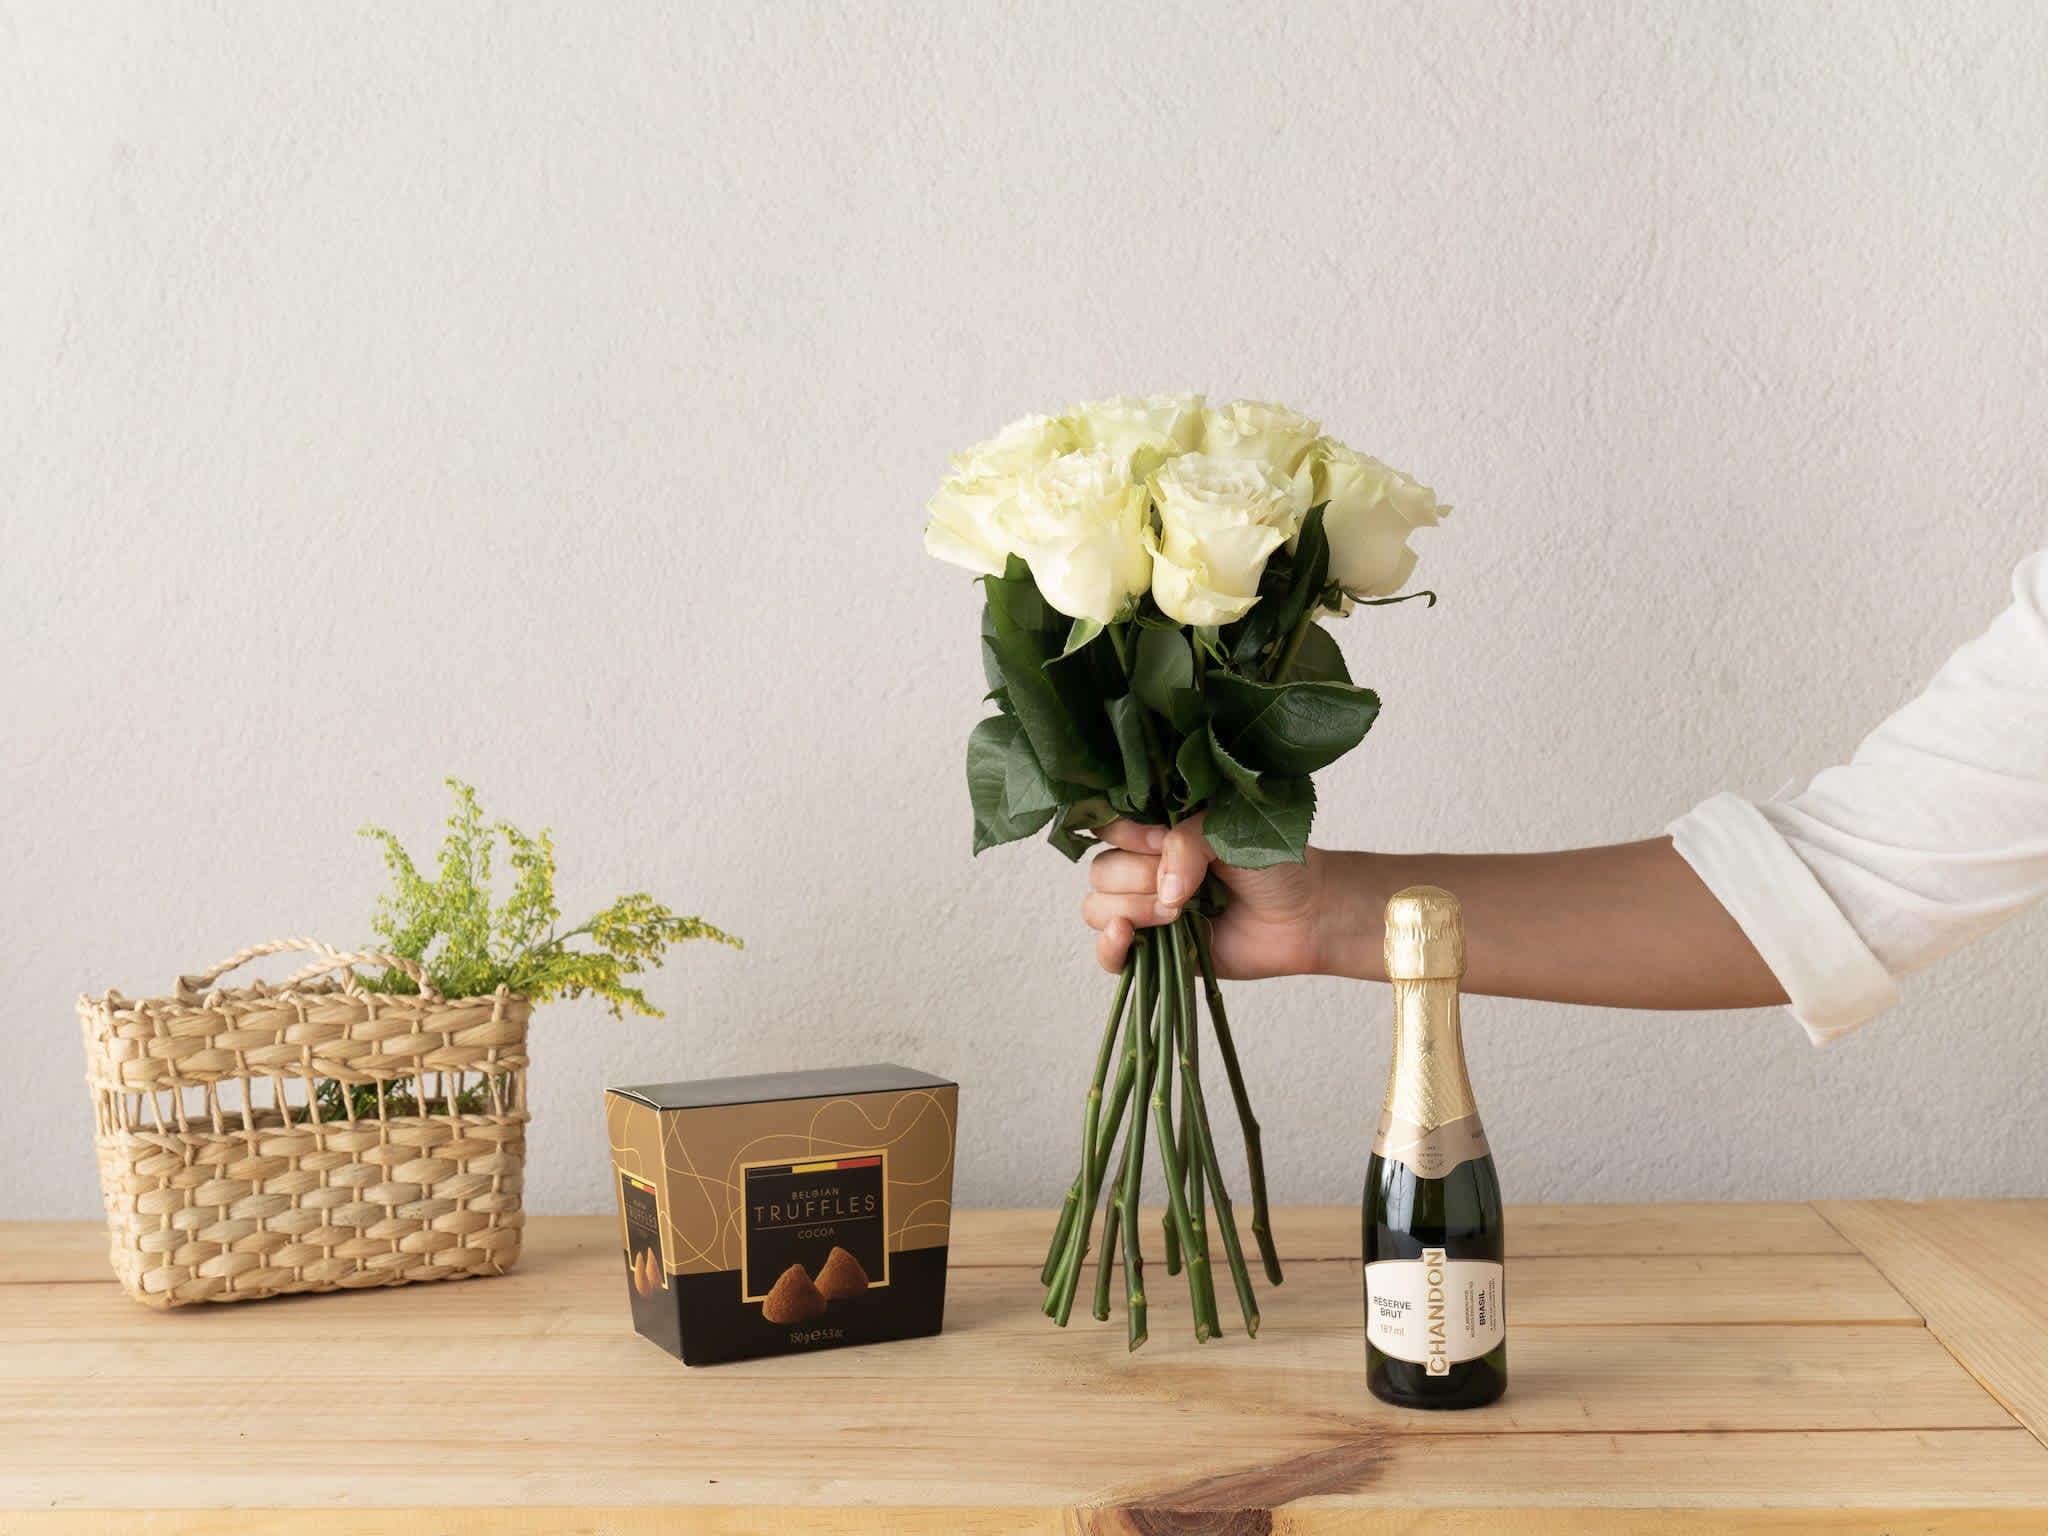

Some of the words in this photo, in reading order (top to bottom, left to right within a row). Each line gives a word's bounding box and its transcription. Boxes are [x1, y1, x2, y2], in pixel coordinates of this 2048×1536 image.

[792, 1187, 839, 1200] BELGIAN
[754, 1194, 875, 1222] TRUFFLES
[798, 1227, 835, 1240] COCOA
[1380, 1308, 1402, 1319] BRUT
[1427, 1251, 1447, 1374] CHANDON
[1478, 1289, 1486, 1326] BRASIL
